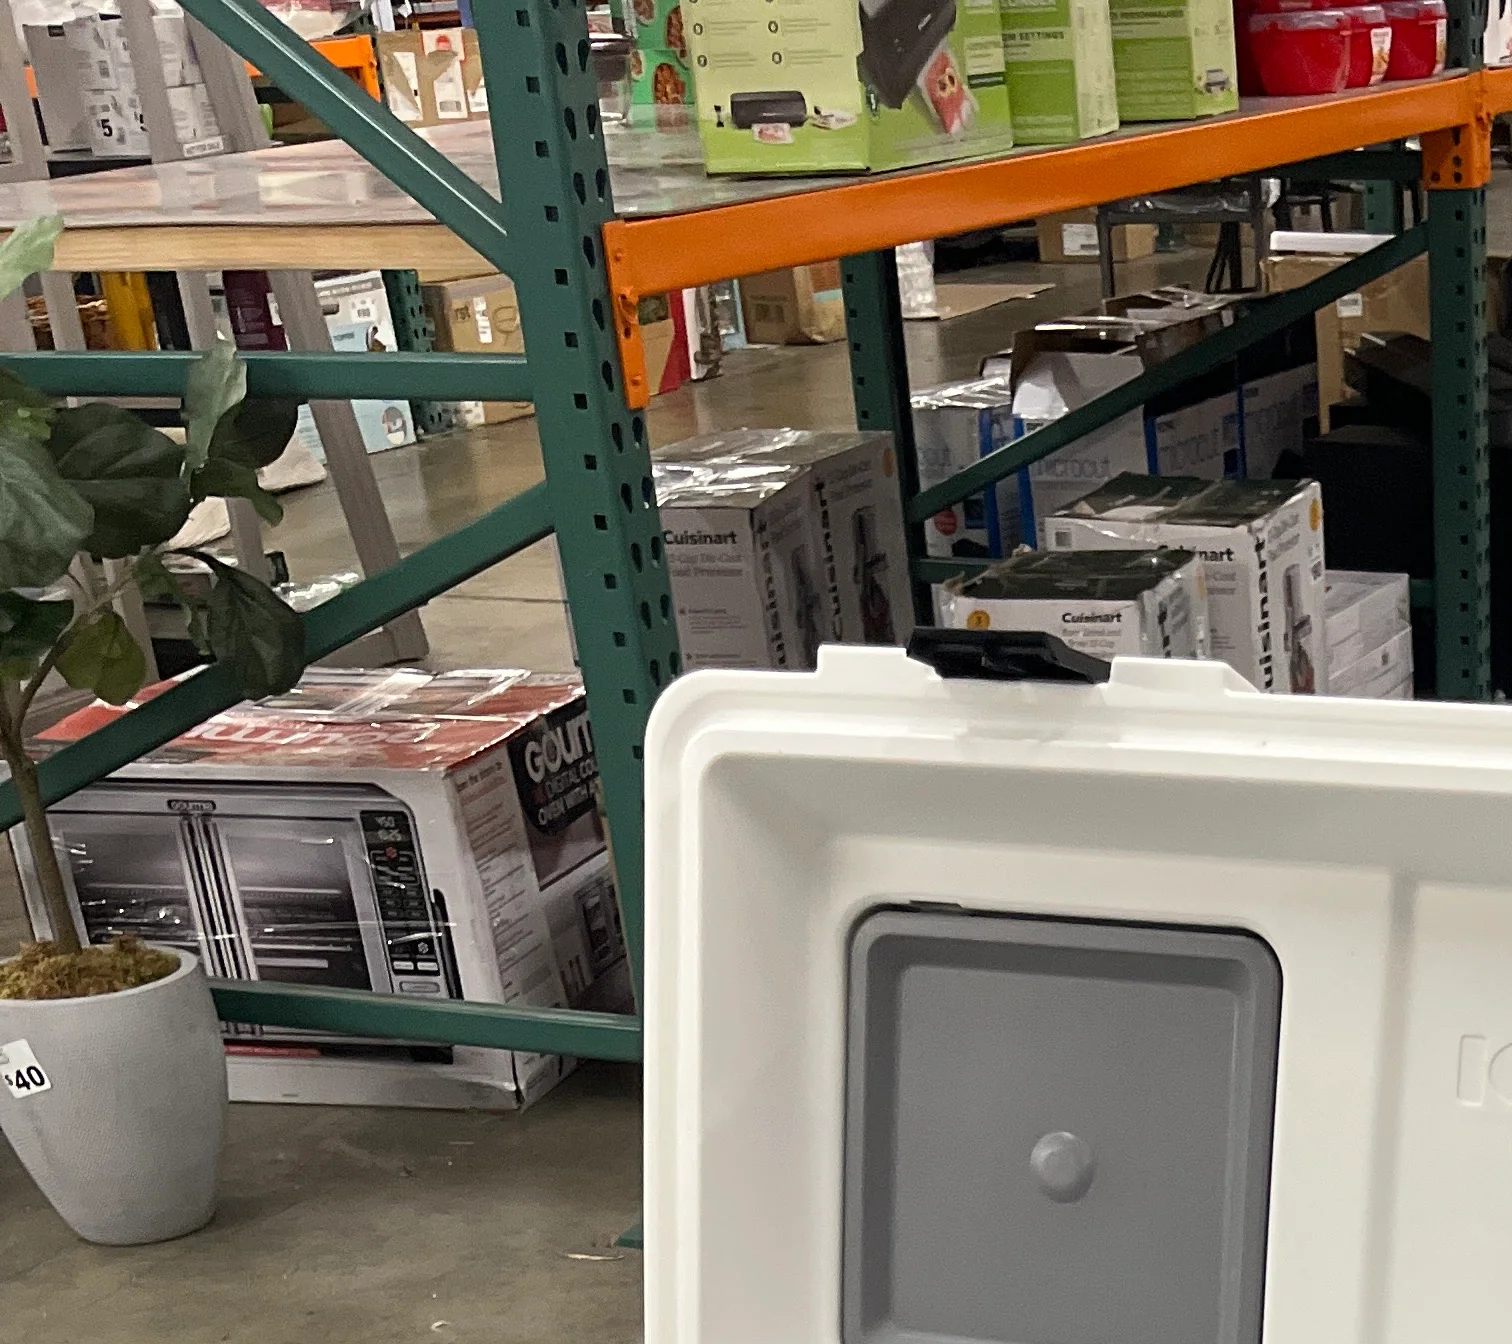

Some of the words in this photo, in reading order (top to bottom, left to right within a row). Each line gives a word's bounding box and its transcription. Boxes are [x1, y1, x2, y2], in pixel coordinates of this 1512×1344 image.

[663, 529, 737, 545] Cuisinart
[1062, 612, 1122, 623] Cuisinart
[1254, 537, 1273, 689] uisinart
[5, 1065, 45, 1090] $40
